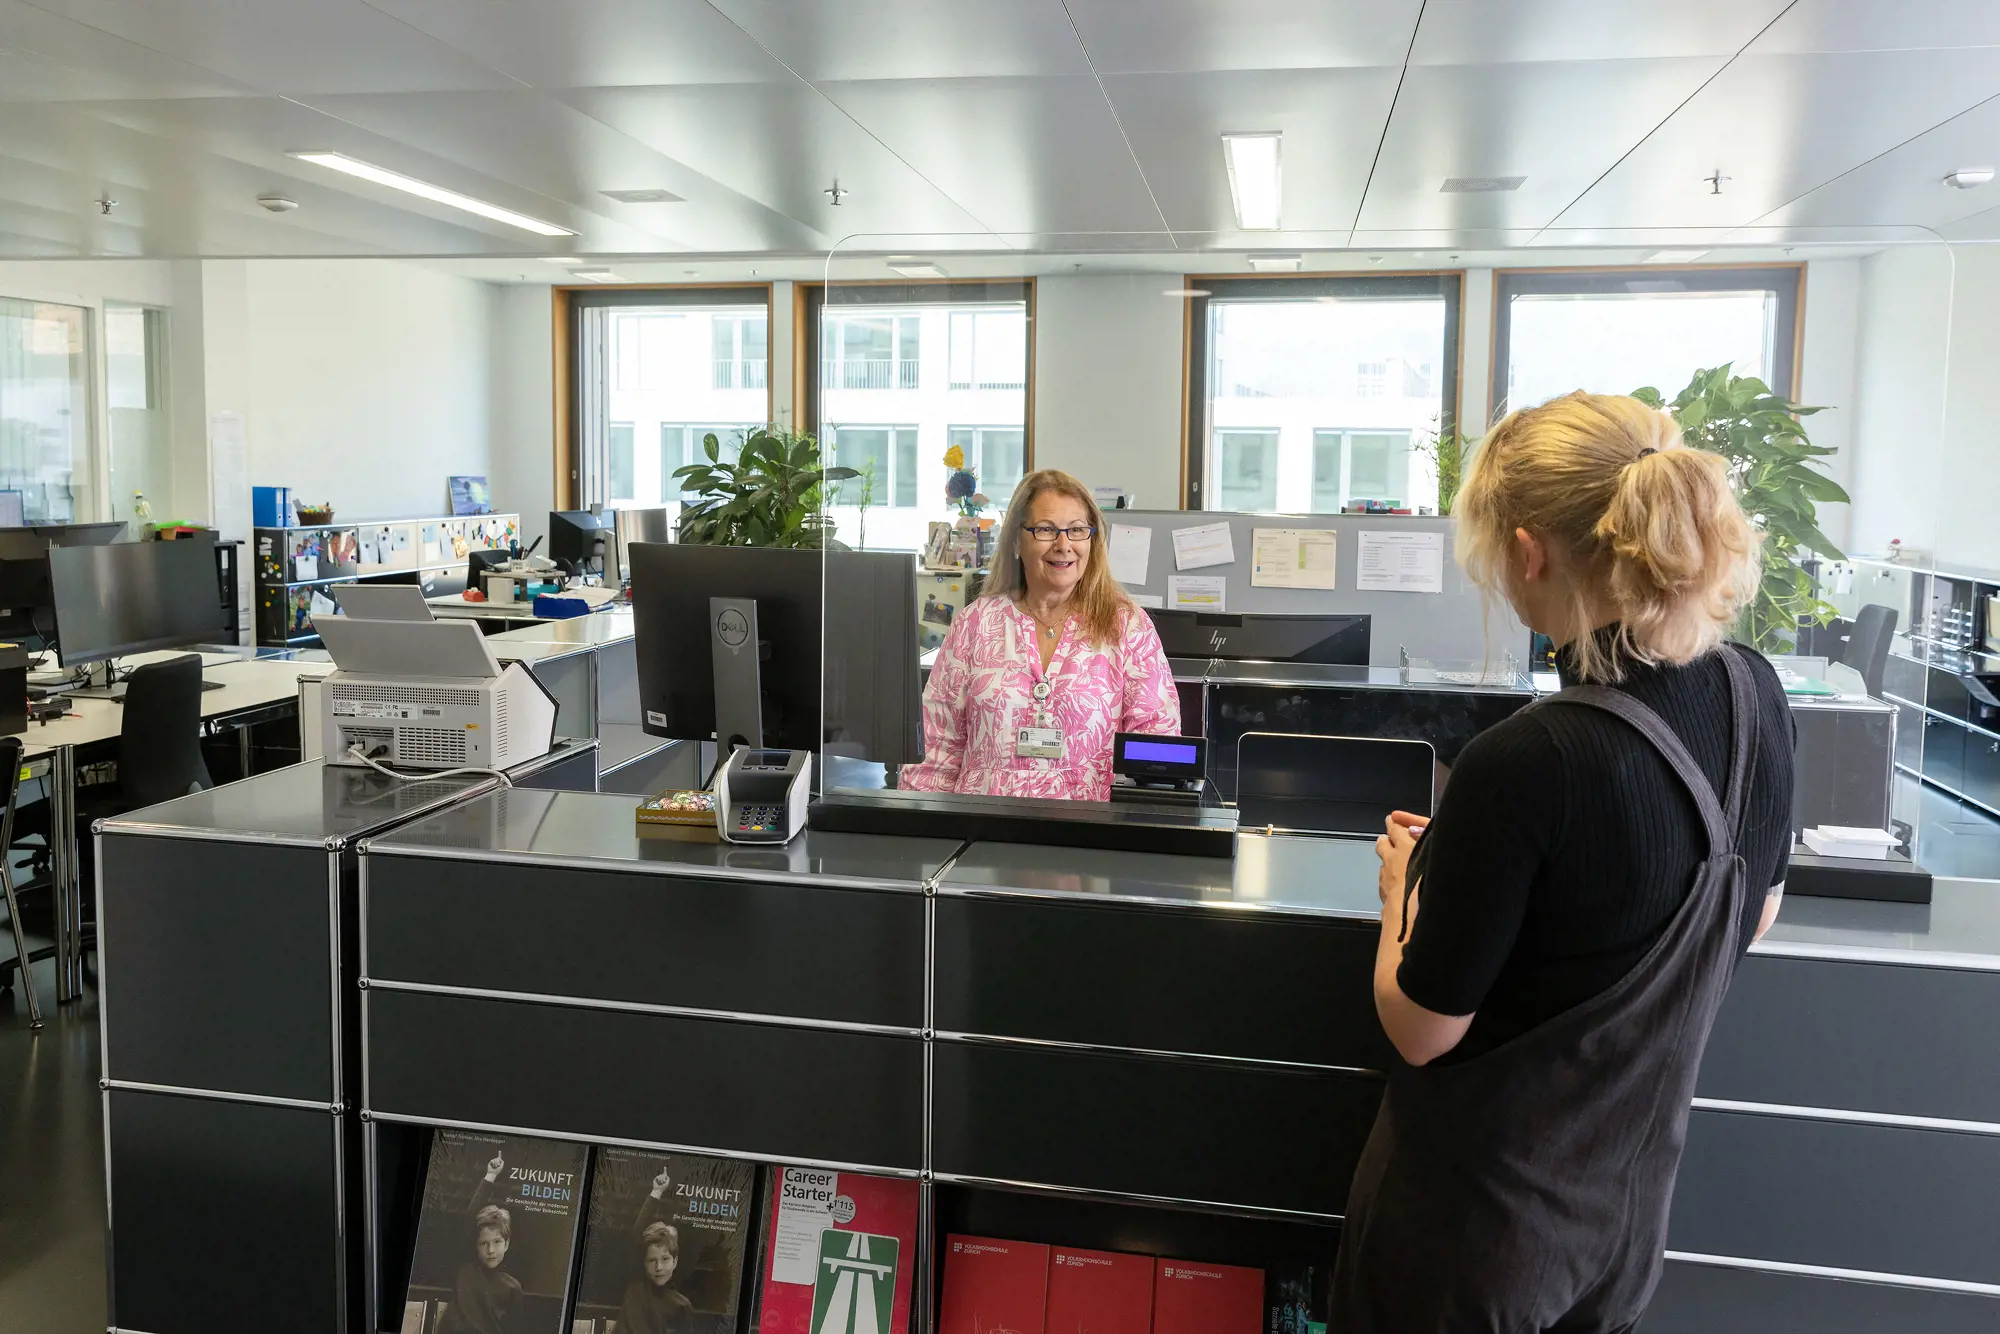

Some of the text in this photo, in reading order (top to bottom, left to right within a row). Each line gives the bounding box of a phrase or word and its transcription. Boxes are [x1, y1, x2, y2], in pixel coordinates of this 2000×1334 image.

[722, 622, 745, 633] DELL
[509, 1167, 574, 1185] ZUKUNFT
[785, 1168, 832, 1186] Career
[522, 1184, 571, 1200] BILDEN
[675, 1184, 741, 1202] ZUKUNFT
[783, 1183, 833, 1202] Starter
[688, 1200, 739, 1218] BILDEN
[963, 1243, 1009, 1254] VOLKSHOCHSCHULE
[1067, 1256, 1112, 1266] VOLKSHOCHSCHULE
[1176, 1268, 1223, 1279] VOLKSHOCHSCHULE
[1272, 1306, 1280, 1329] Soziale
